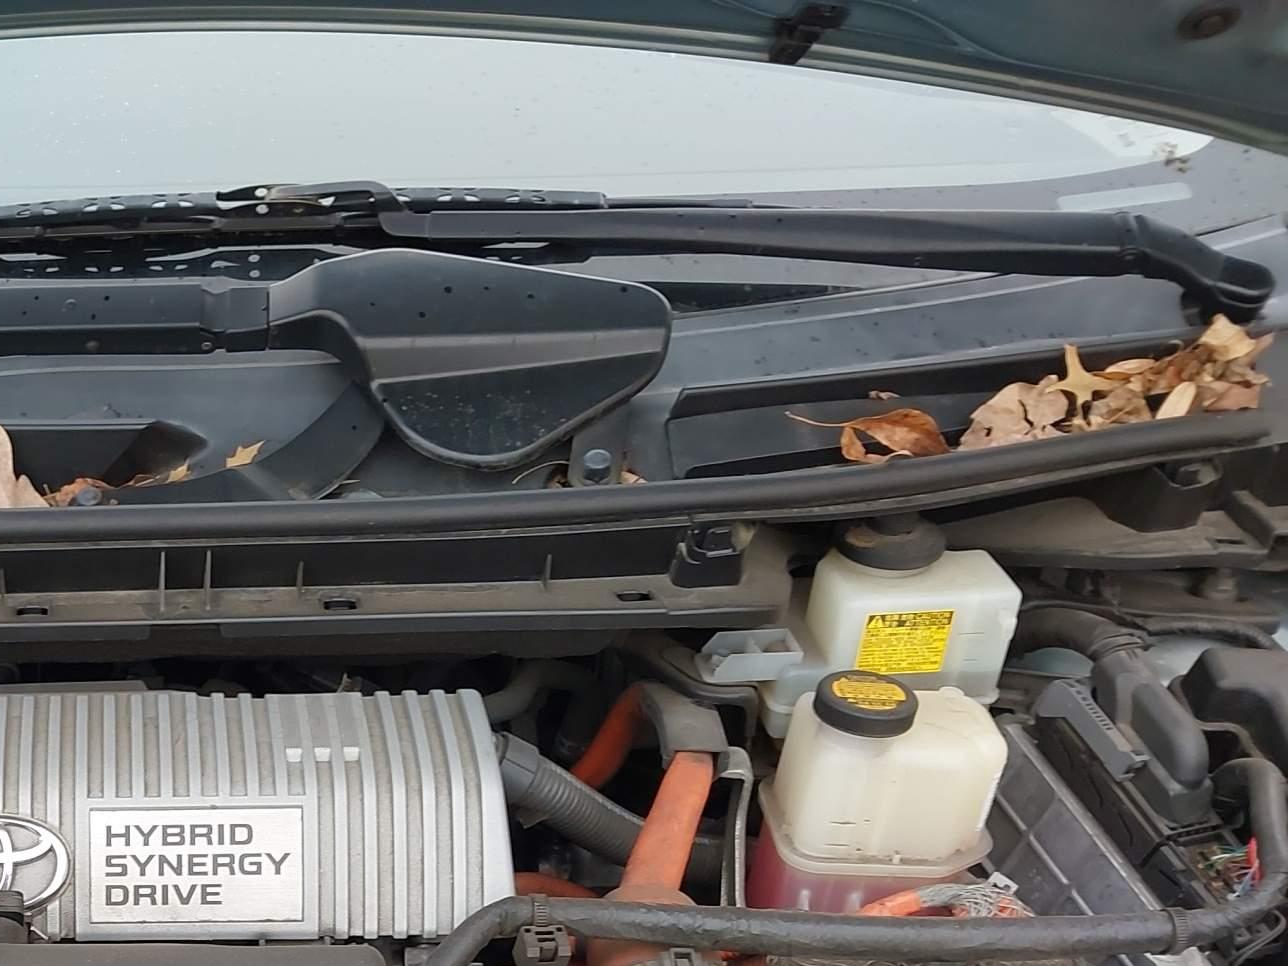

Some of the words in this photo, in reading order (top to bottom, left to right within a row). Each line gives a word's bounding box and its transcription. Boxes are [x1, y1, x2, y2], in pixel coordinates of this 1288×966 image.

[105, 823, 253, 848] HYBRID
[105, 852, 291, 878] SYNERGY
[105, 883, 223, 907] DRIVE
